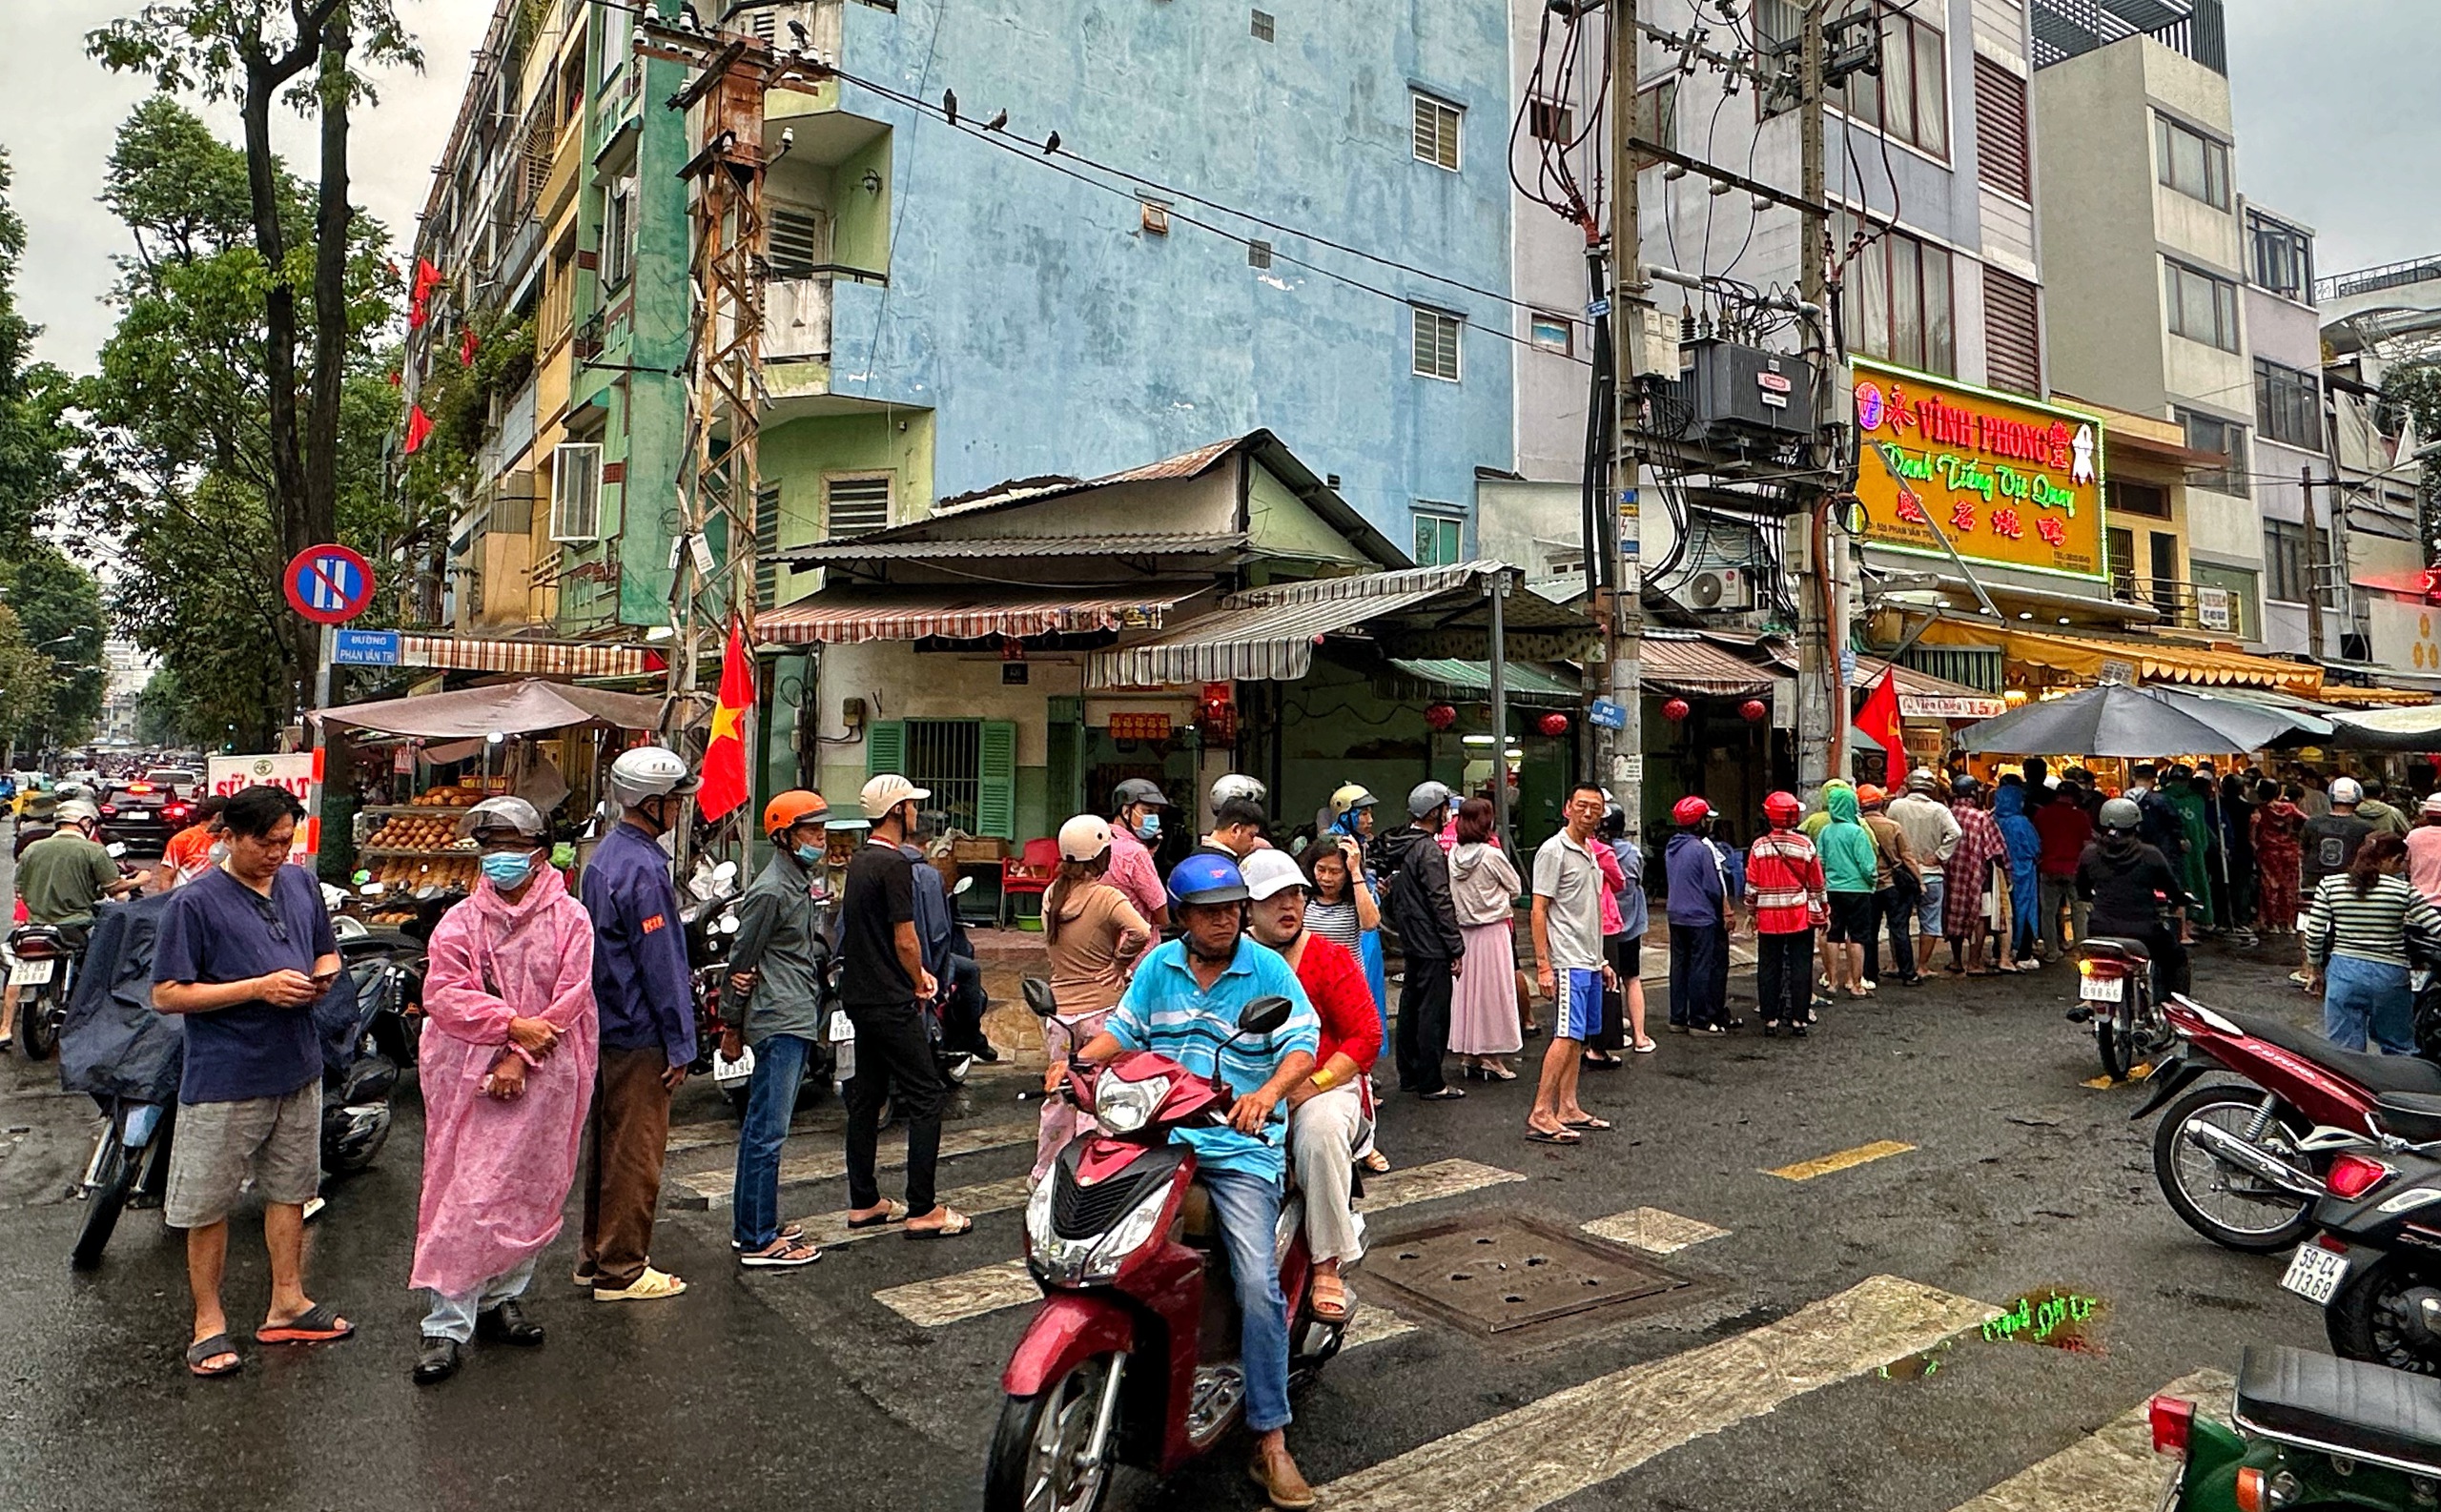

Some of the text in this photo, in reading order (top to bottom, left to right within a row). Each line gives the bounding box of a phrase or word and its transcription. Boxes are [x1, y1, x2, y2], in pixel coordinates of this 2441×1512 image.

[1980, 416, 2048, 462] PHONG
[1882, 442, 1933, 481] Danh
[1937, 453, 1994, 501] Tiếng
[2031, 474, 2075, 518] Quay
[339, 649, 362, 660] PHAN
[364, 648, 380, 662] VĂN
[2320, 837, 2345, 867] 8
[2299, 1248, 2339, 1277] 59-C4
